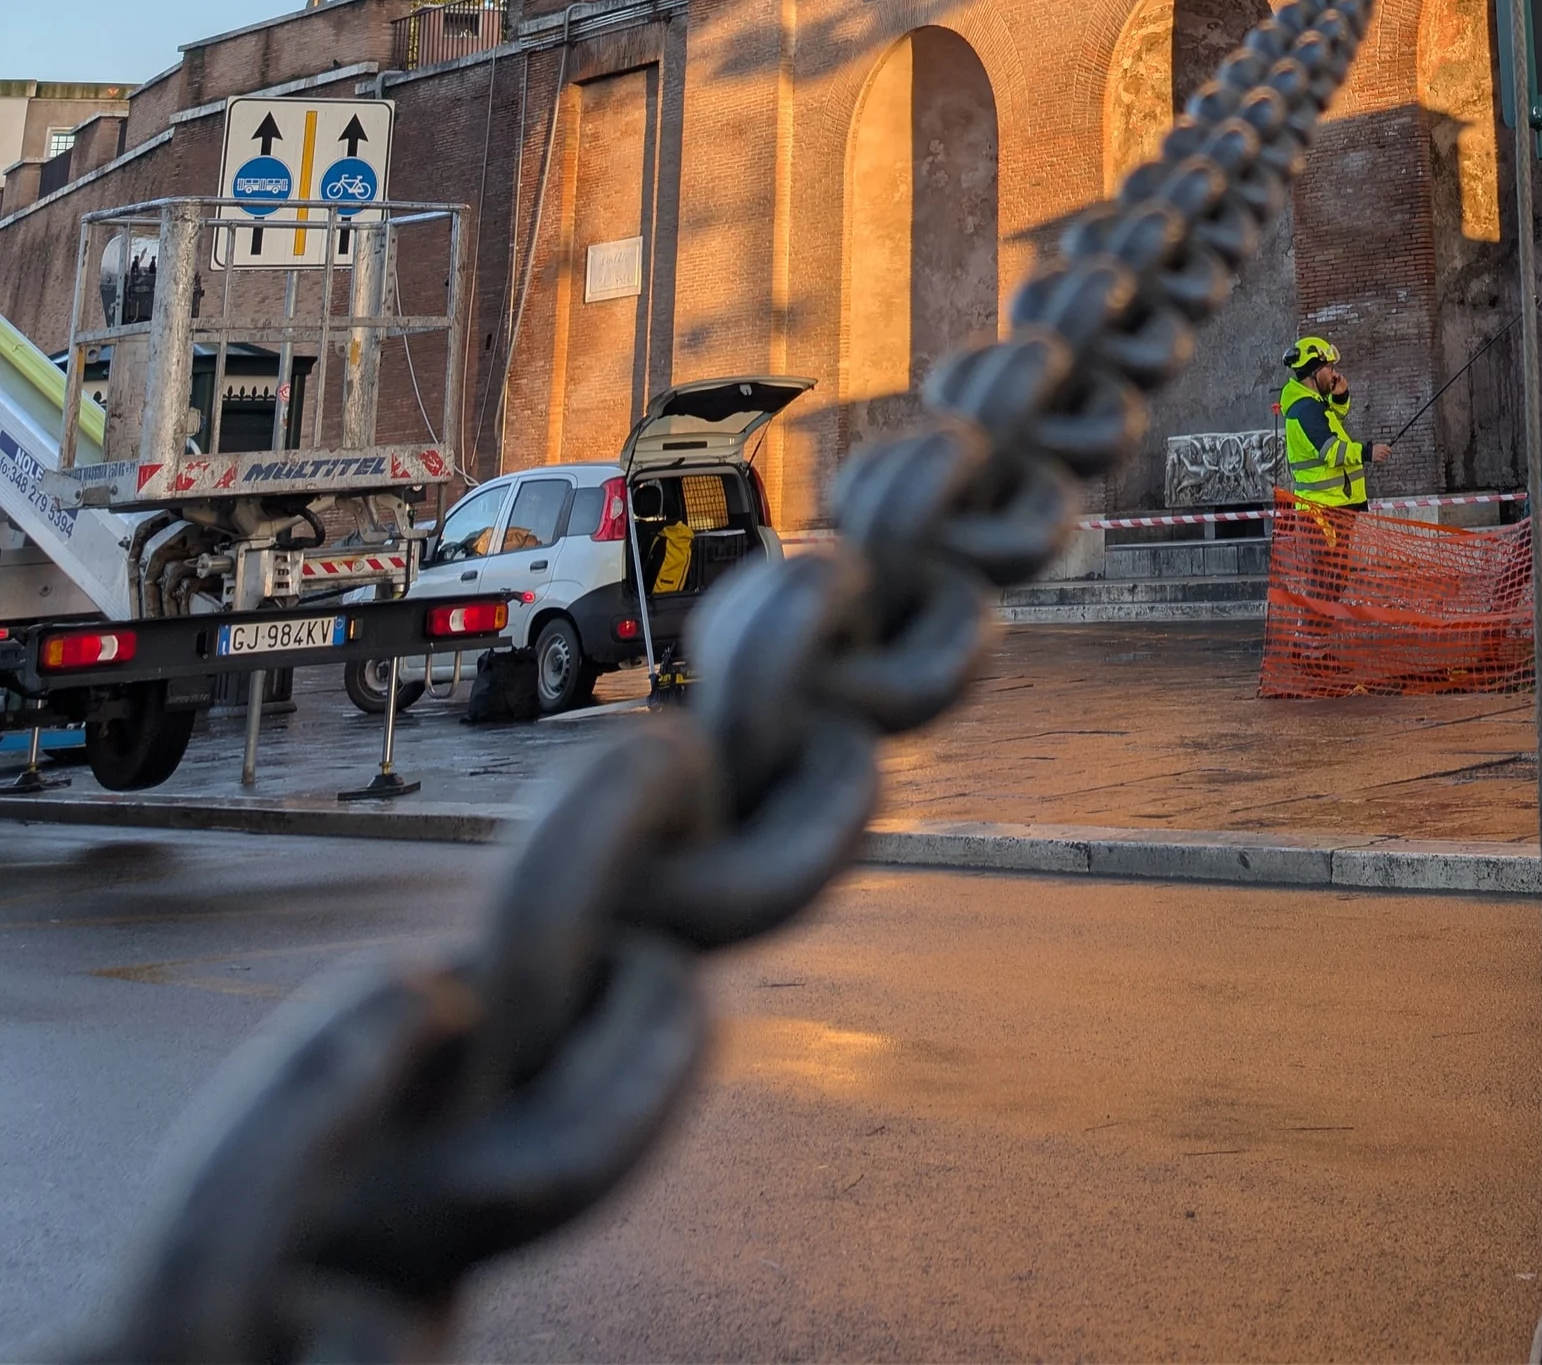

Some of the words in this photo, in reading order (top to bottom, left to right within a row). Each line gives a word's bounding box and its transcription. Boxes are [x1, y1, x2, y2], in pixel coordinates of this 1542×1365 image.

[15, 447, 45, 483] NOLE
[242, 456, 387, 483] MULTITEL
[27, 486, 47, 513] 279
[232, 625, 260, 651] GJ
[267, 619, 332, 648] 984KV
